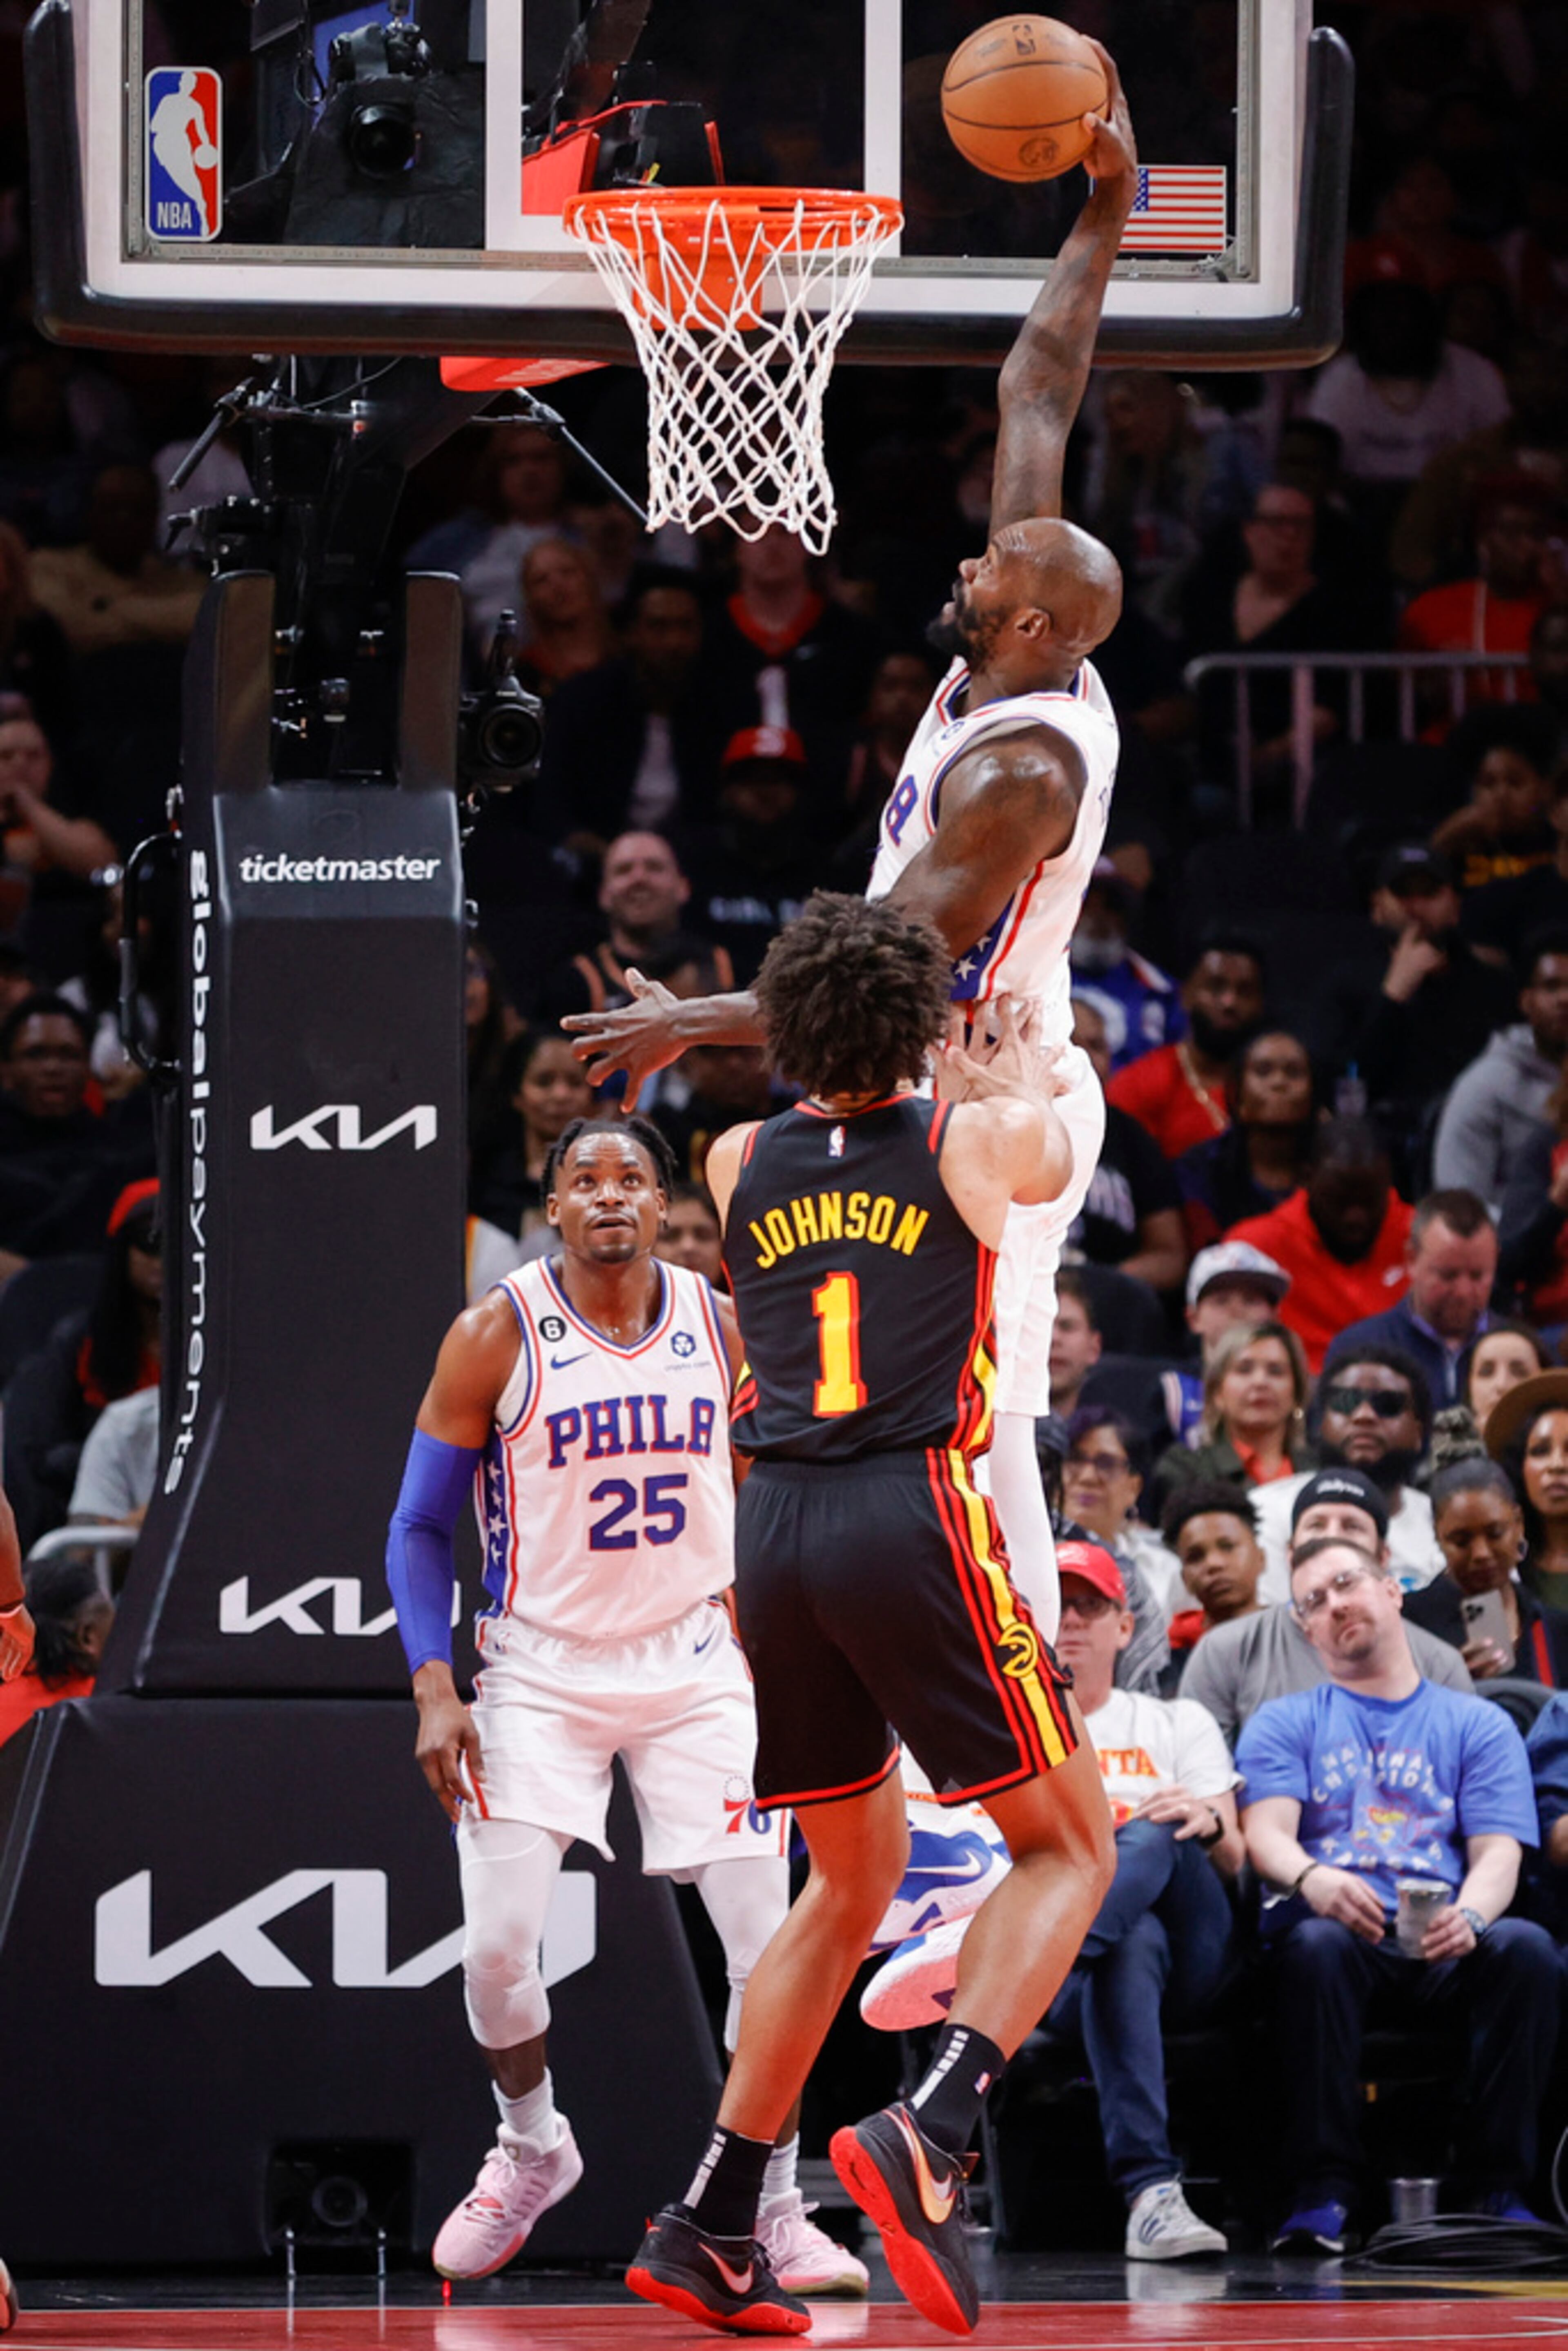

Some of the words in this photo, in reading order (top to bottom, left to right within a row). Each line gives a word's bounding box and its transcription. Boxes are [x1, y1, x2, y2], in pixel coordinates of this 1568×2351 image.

[158, 202, 192, 229] NBA
[239, 853, 441, 882] ticketmaster
[250, 1104, 437, 1150] KIA
[748, 1191, 930, 1268] JOHNSON
[812, 1271, 868, 1418] 1
[545, 1394, 715, 1469] PHILA
[589, 1473, 688, 1551] 25
[724, 1797, 772, 1834] 76
